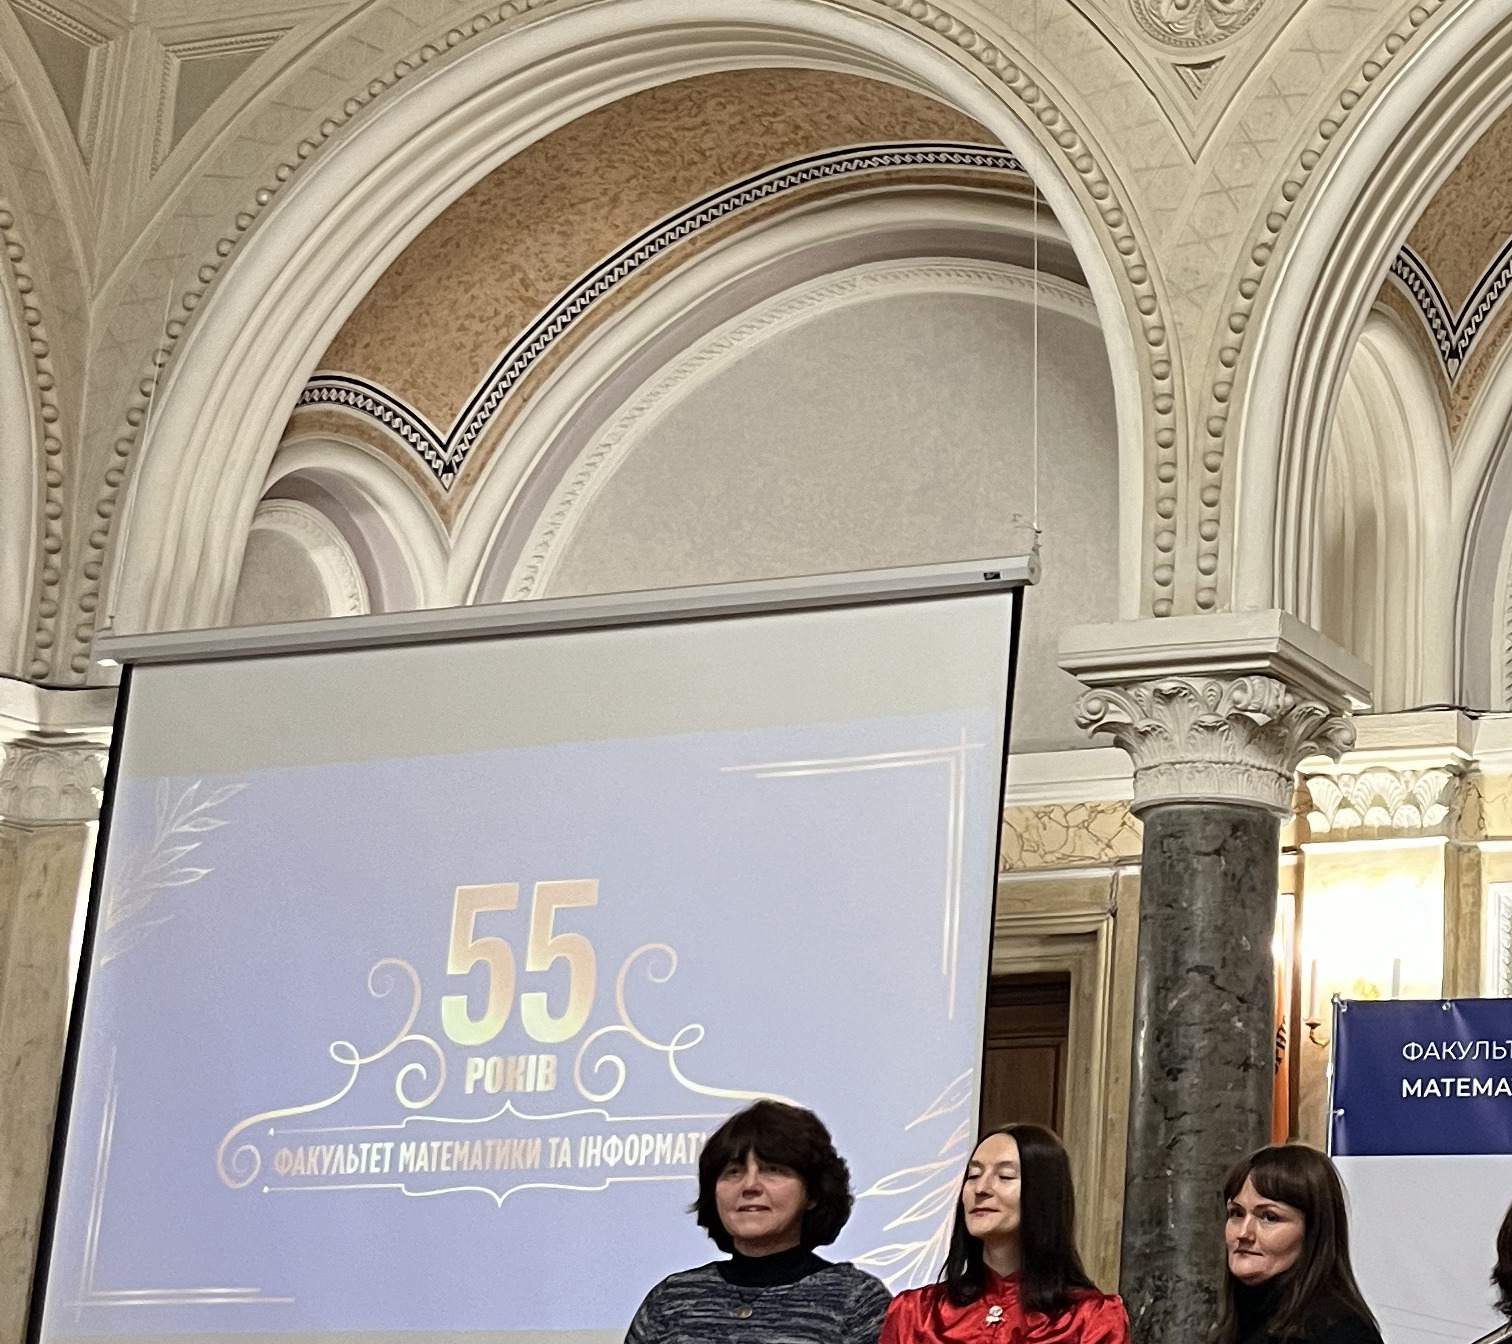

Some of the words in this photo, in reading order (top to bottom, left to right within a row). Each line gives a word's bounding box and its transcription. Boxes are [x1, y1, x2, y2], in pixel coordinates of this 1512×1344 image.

[442, 878, 599, 1046] 55
[465, 1054, 557, 1094] РОКІВ
[274, 1142, 394, 1176] ФАКУЛЬТЕТ
[399, 1138, 542, 1174] МАТЕМАТИКИ
[549, 1137, 571, 1168] ТА
[579, 1132, 705, 1167] ІНФОРМАТ
